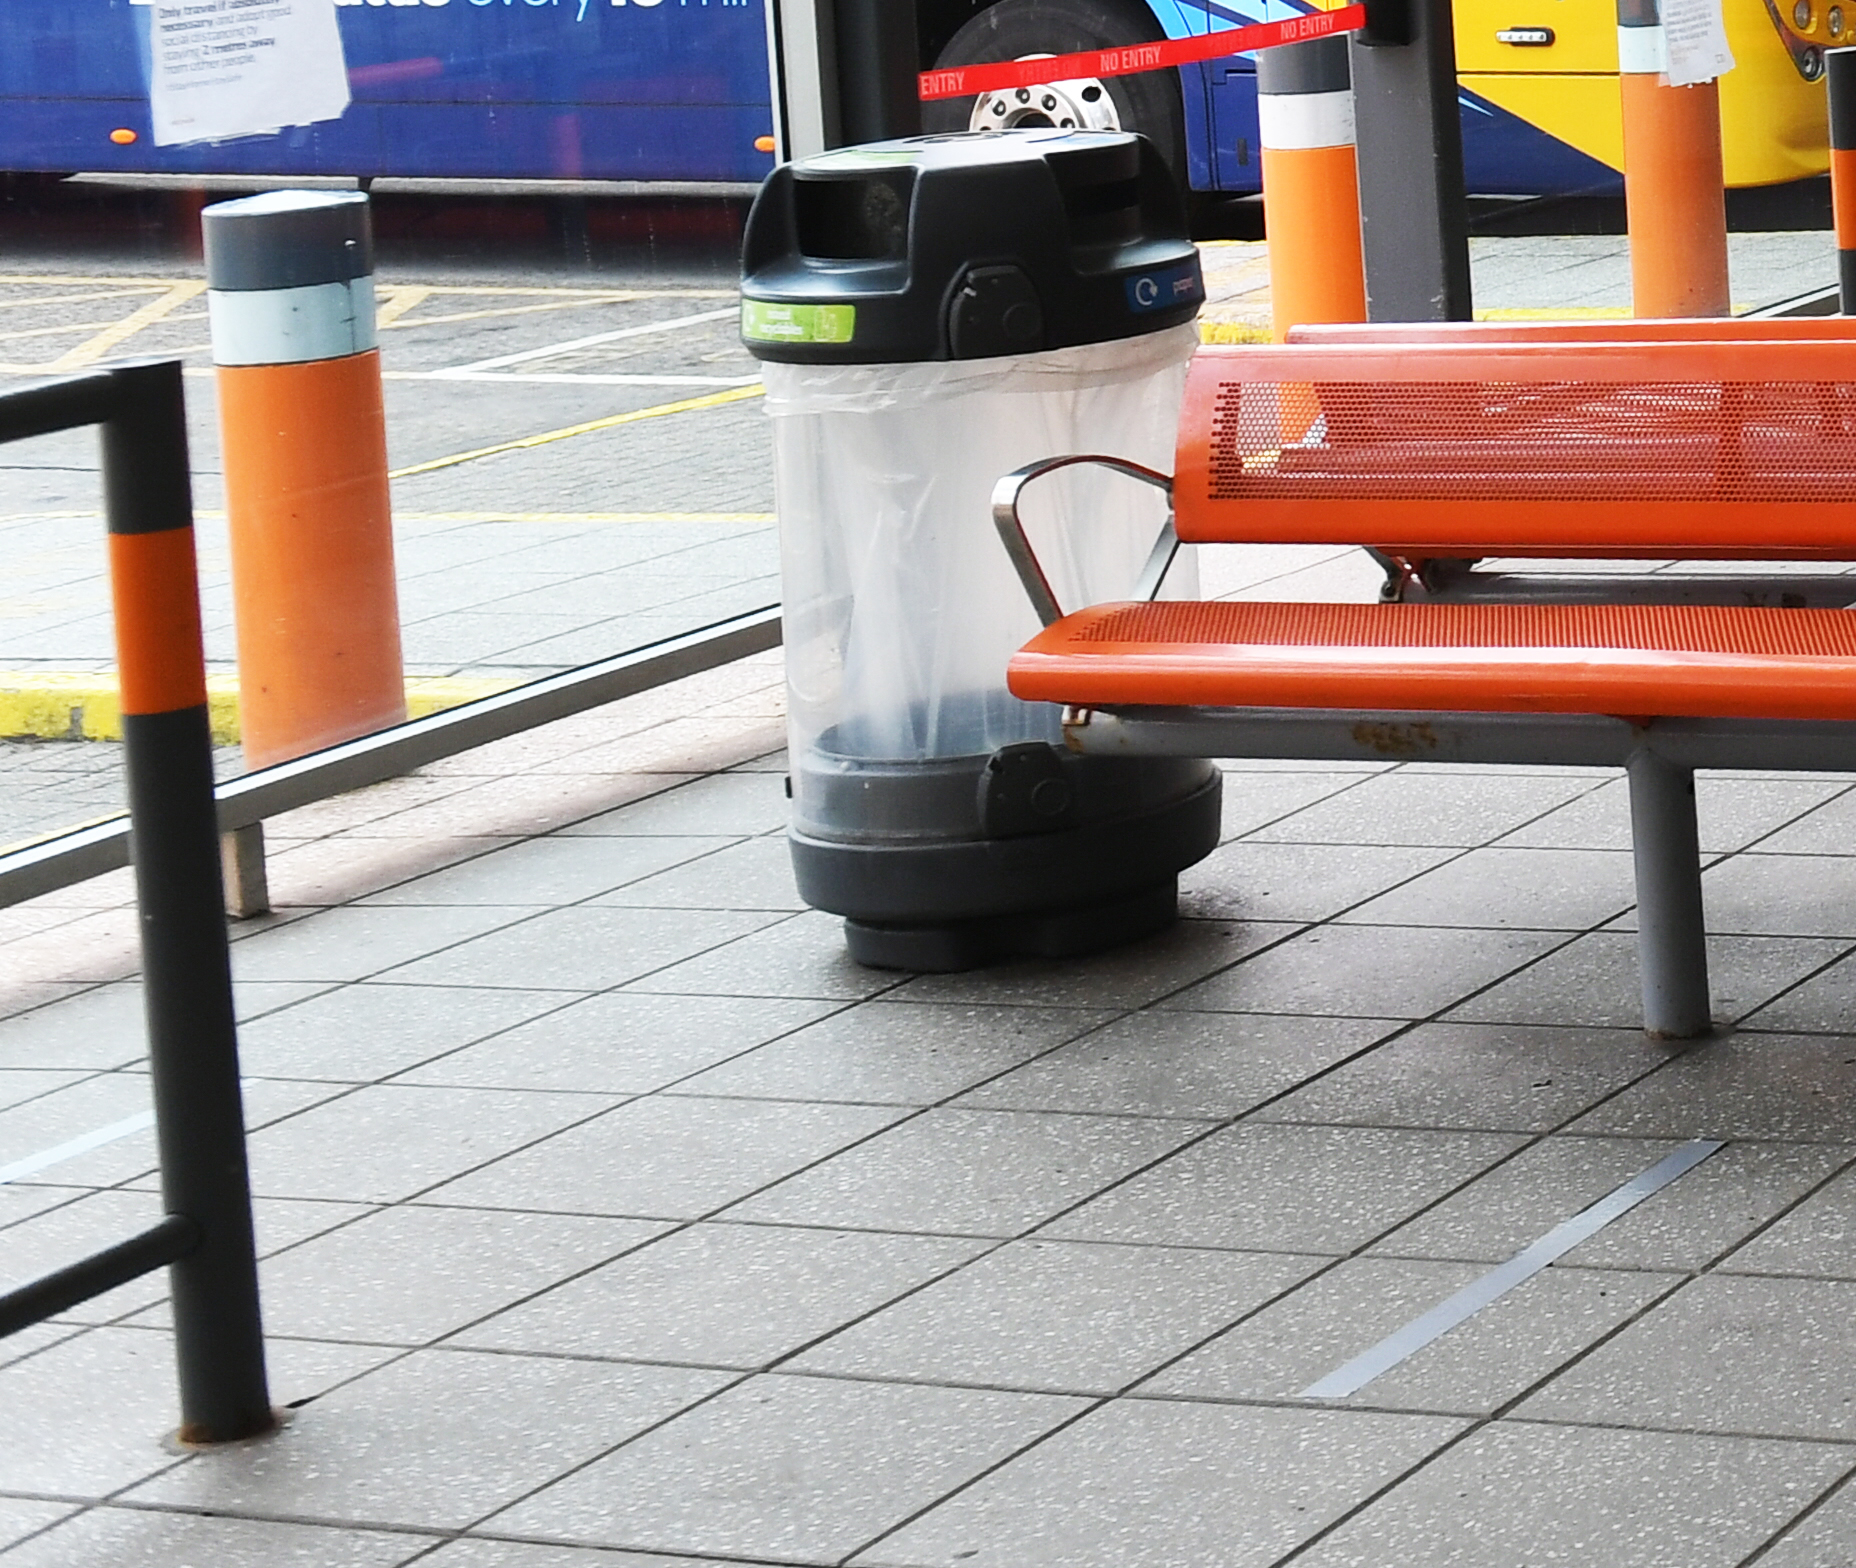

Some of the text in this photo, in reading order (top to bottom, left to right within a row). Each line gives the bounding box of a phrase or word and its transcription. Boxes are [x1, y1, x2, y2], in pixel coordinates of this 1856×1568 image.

[158, 7, 181, 20] Only
[183, 2, 217, 15] travel
[160, 5, 292, 34] necessary and adopt good
[161, 34, 189, 47] social
[190, 27, 244, 44] distancing
[1280, 14, 1335, 40] NO ENTRY
[162, 48, 200, 63] staying
[211, 41, 247, 54] metres
[248, 37, 276, 51] away
[1100, 45, 1161, 72] NO ENTRY
[164, 63, 189, 75] from
[189, 58, 220, 72] other
[920, 72, 964, 94] ENTRY
